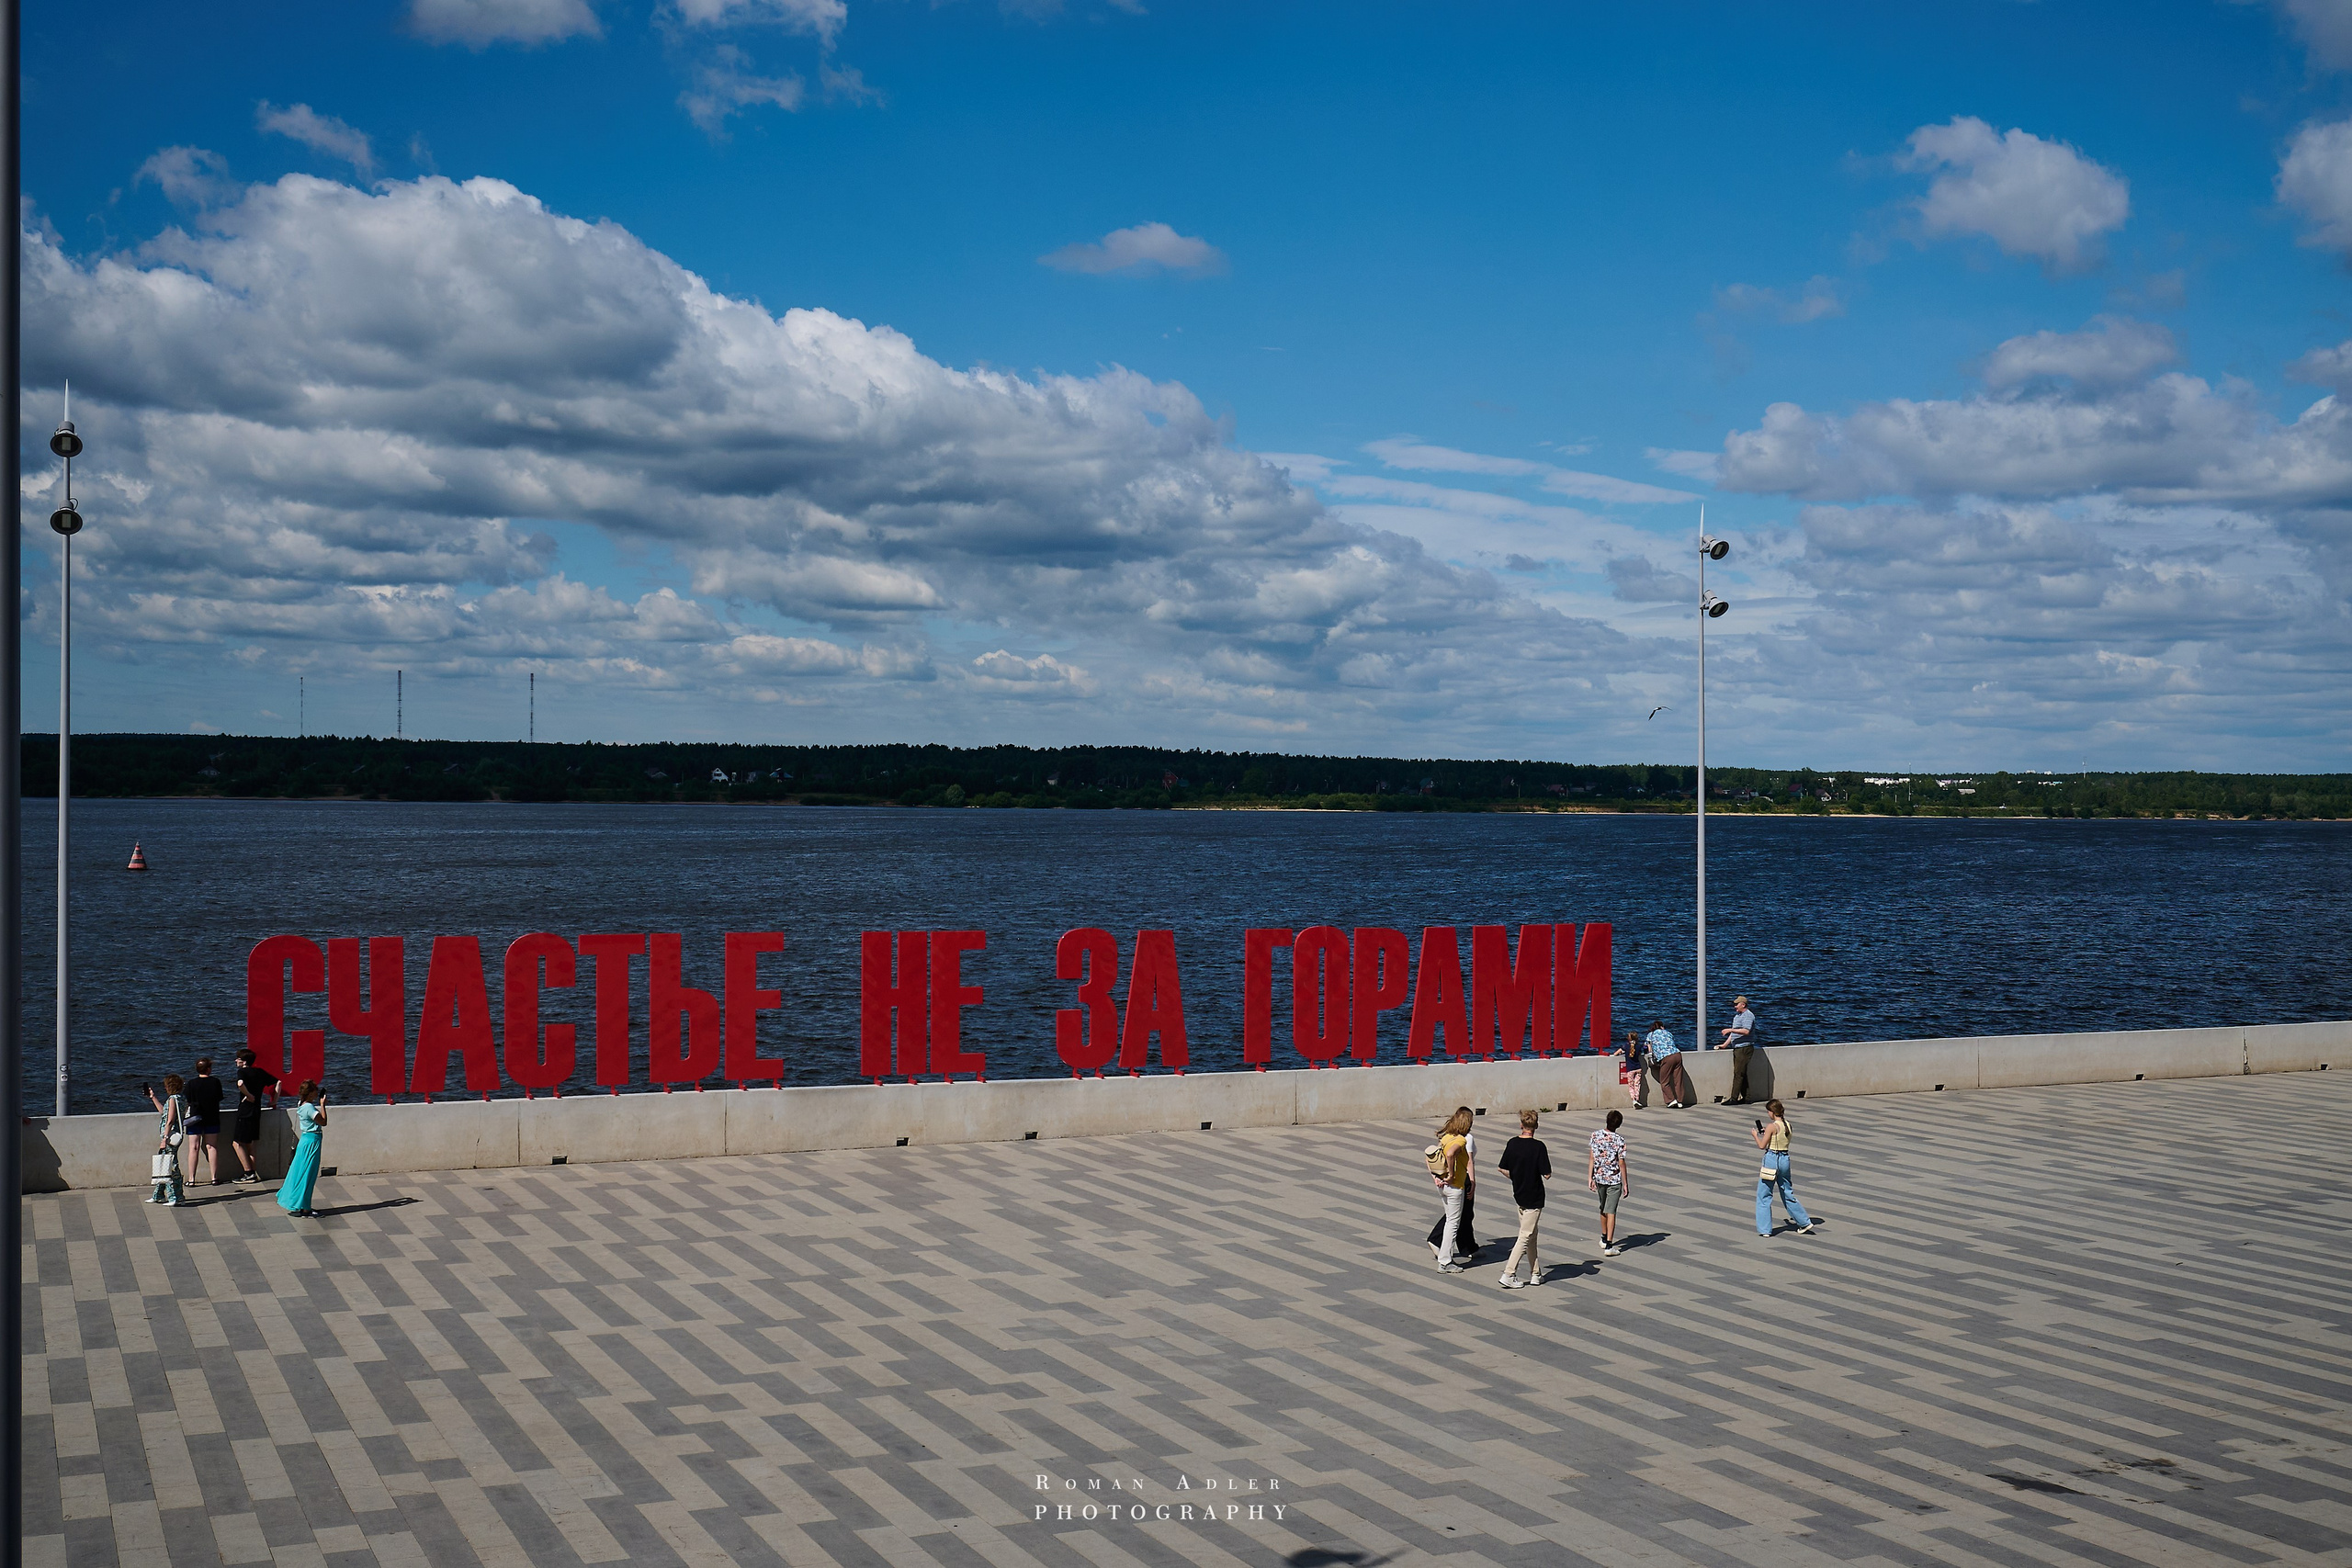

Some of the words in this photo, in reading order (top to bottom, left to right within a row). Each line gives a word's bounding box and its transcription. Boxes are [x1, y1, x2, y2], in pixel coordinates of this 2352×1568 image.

[247, 931, 784, 1096] СЧАСТЬЕ
[861, 931, 986, 1077] НЕ
[1056, 928, 1190, 1069] ЗА
[1244, 923, 1612, 1064] ГОРАМИ
